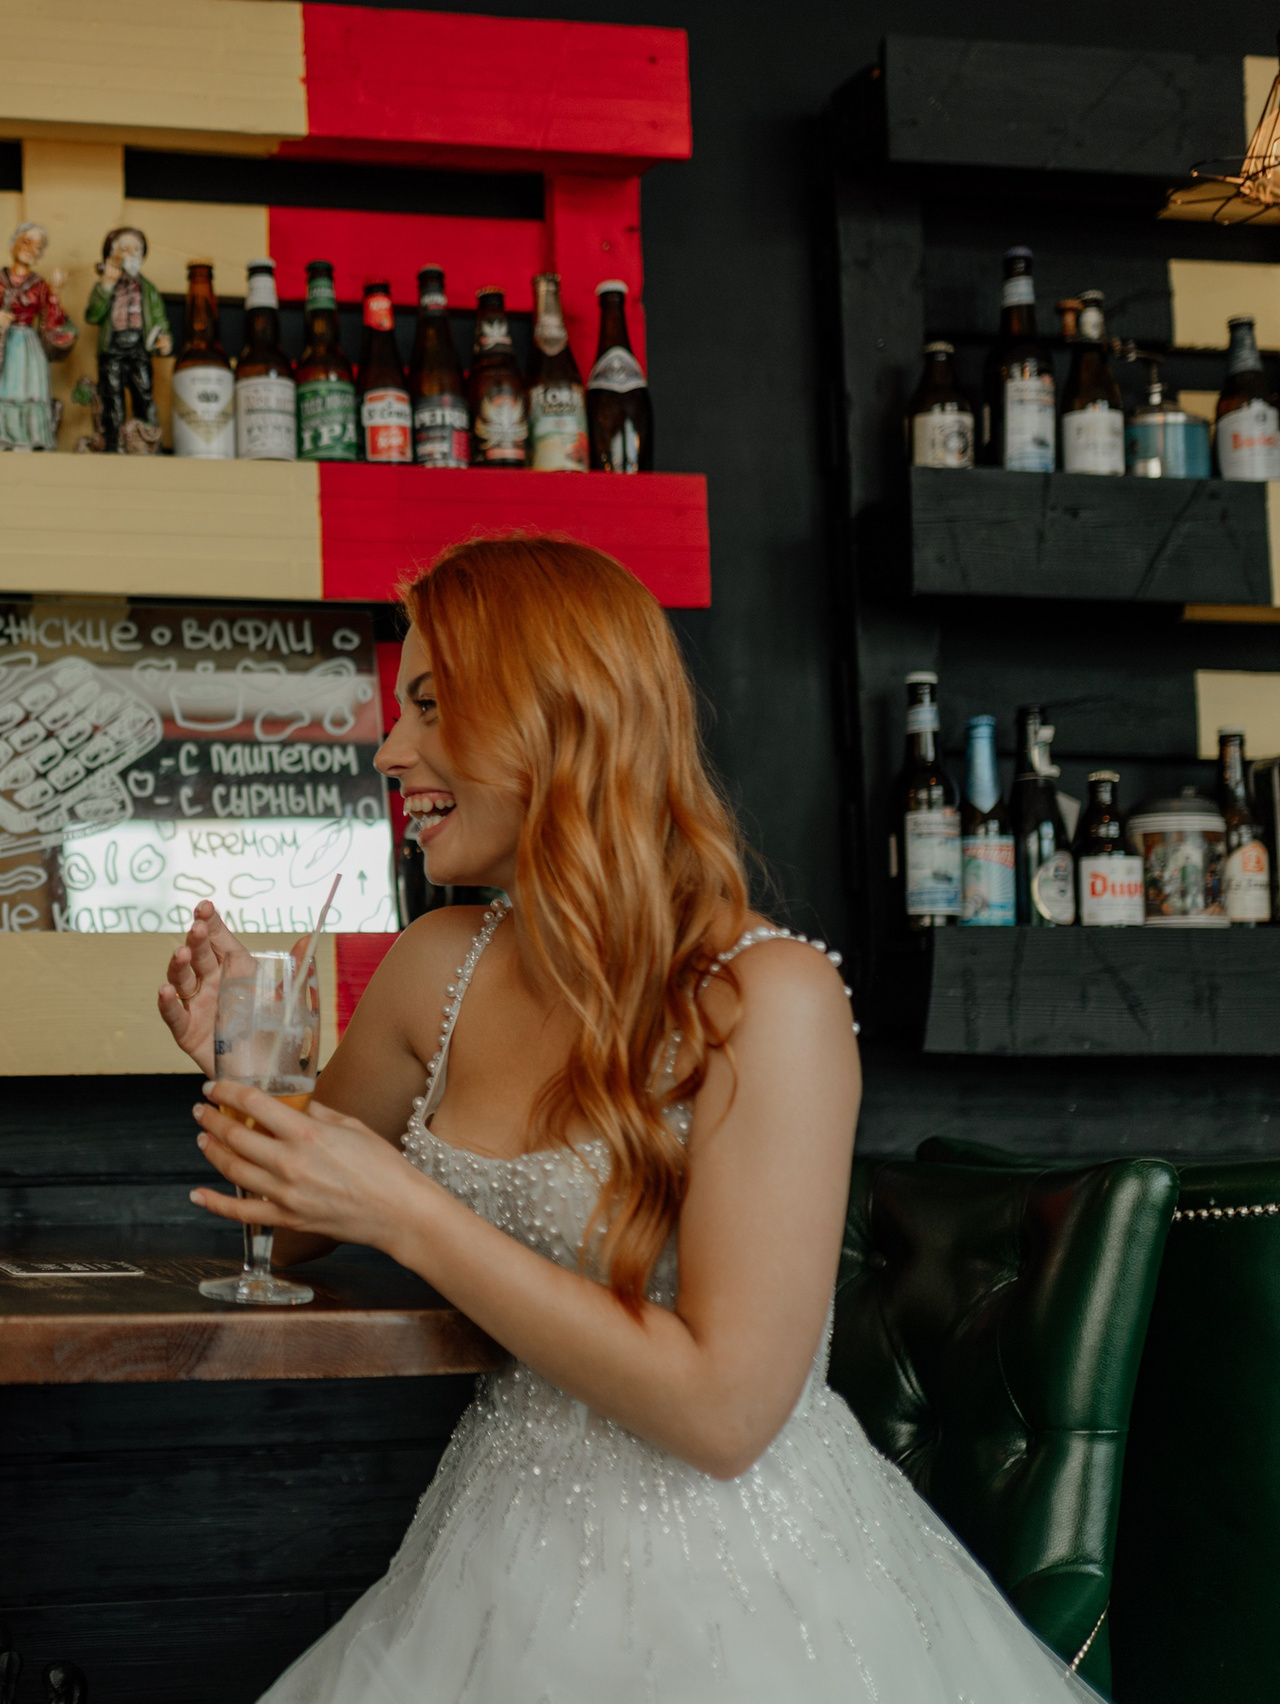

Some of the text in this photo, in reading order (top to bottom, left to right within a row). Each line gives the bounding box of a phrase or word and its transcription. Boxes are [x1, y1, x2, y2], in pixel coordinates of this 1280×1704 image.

[181, 617, 314, 654] ВАФЛИ
[188, 829, 300, 858] КРЕМОМ
[51, 903, 342, 933] КАРТОФЛЬНЫЕ
